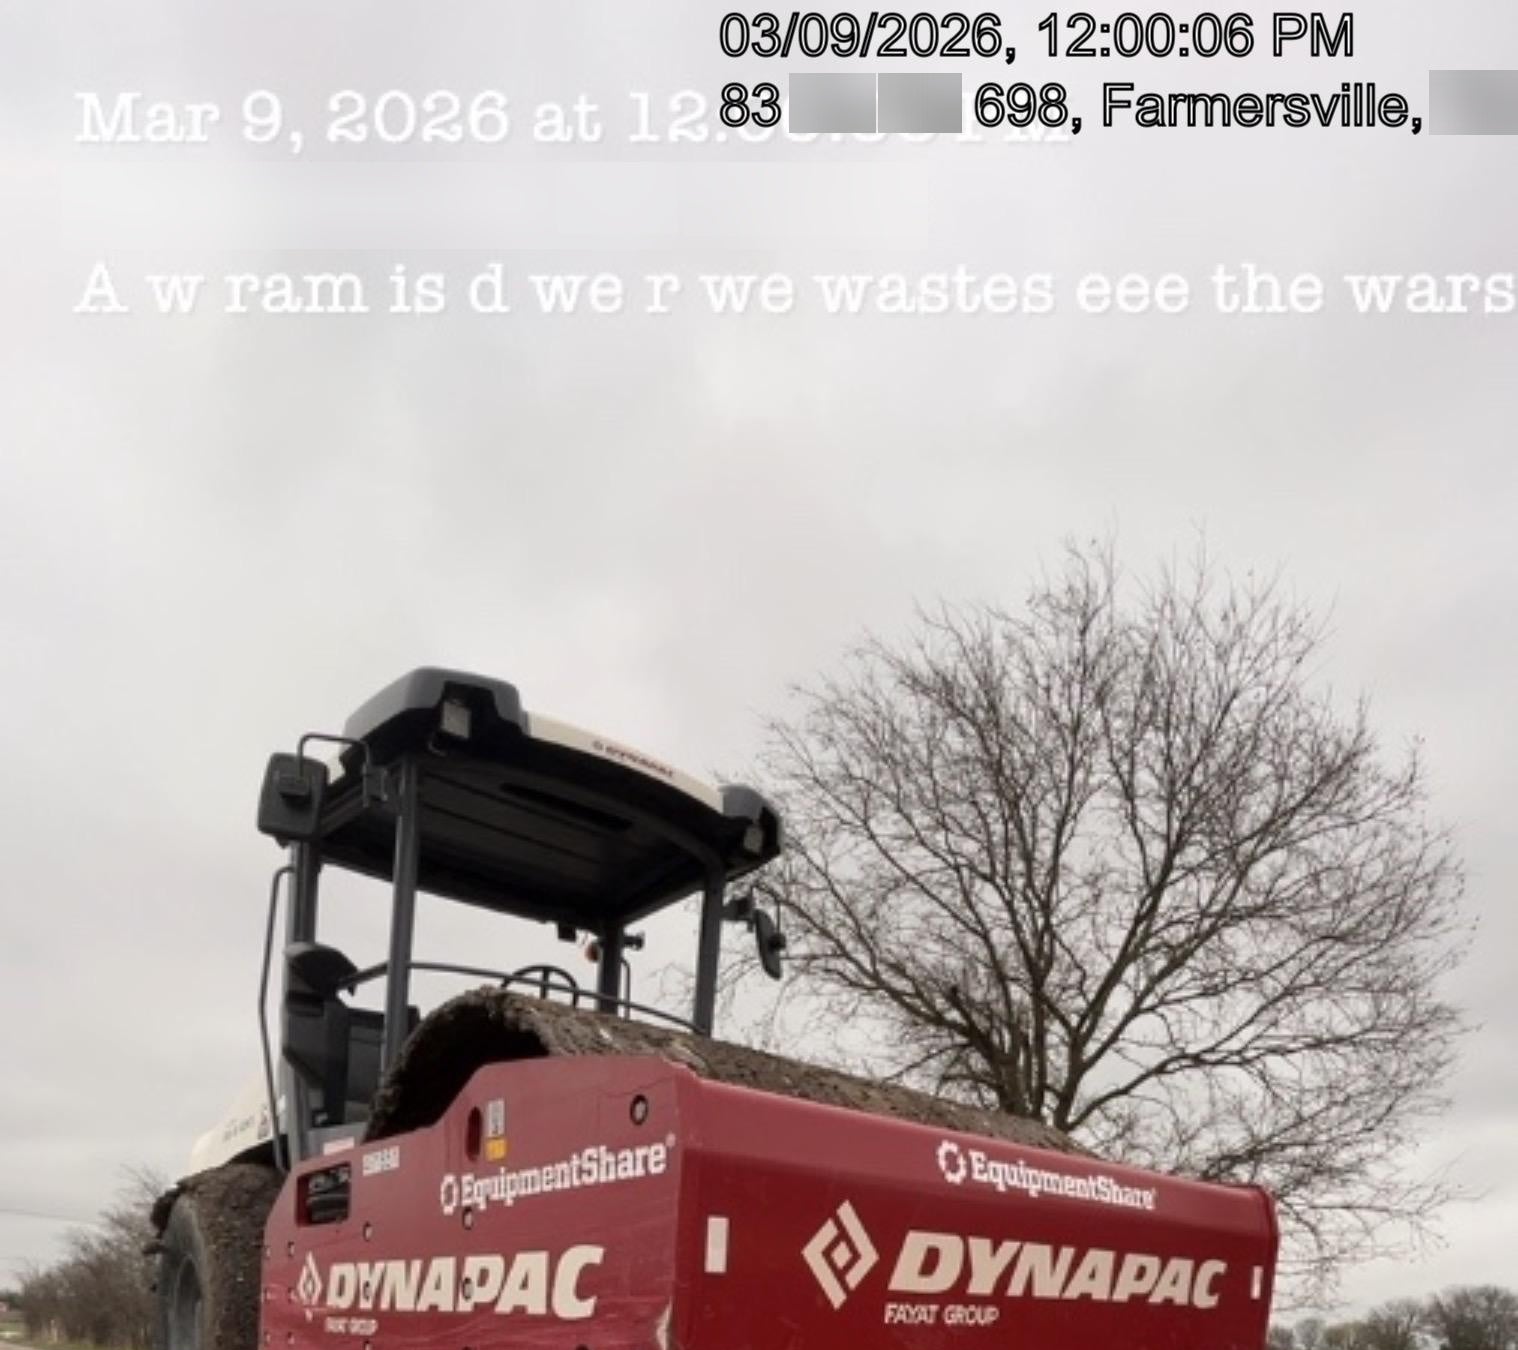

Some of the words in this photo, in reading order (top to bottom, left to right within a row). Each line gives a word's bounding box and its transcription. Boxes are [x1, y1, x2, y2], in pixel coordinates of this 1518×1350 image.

[461, 1141, 667, 1211] EquipmentShare
[968, 1149, 1156, 1210] EquipmentShare
[325, 1244, 605, 1319] DYNAPAC
[888, 1230, 1227, 1309] DYNAPAC
[884, 1303, 939, 1325] FAYAT
[944, 1304, 1000, 1326] GROUP
